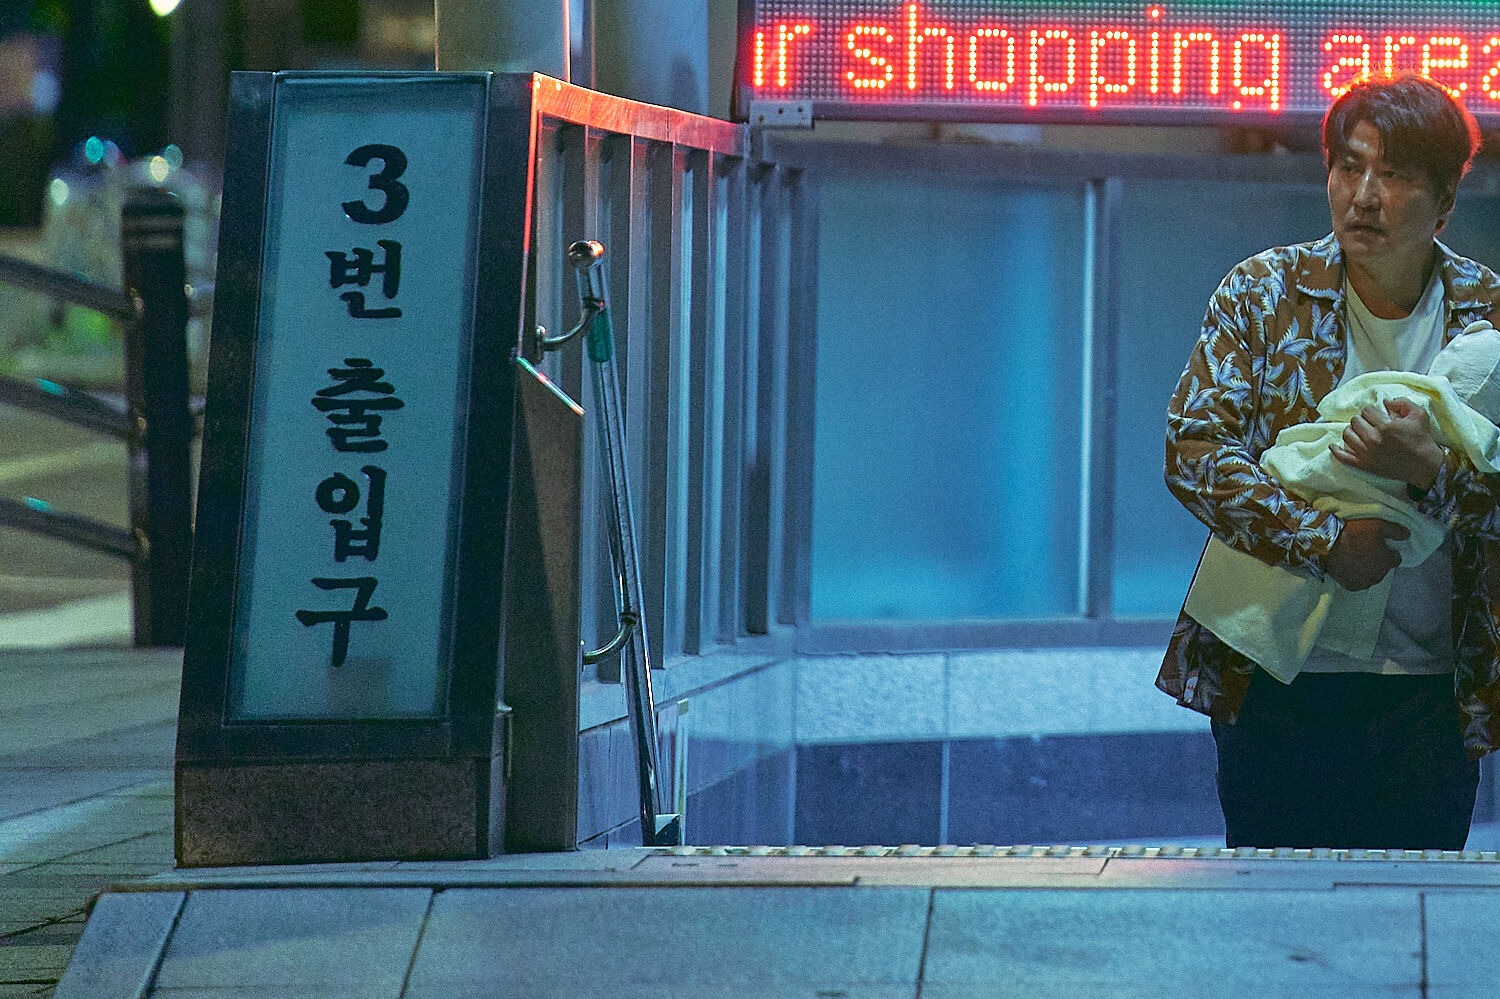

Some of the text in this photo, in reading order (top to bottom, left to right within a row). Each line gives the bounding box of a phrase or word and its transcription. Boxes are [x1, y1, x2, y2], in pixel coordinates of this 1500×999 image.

[846, 2, 1280, 111] shopping
[295, 143, 410, 668] 3번 출입구
